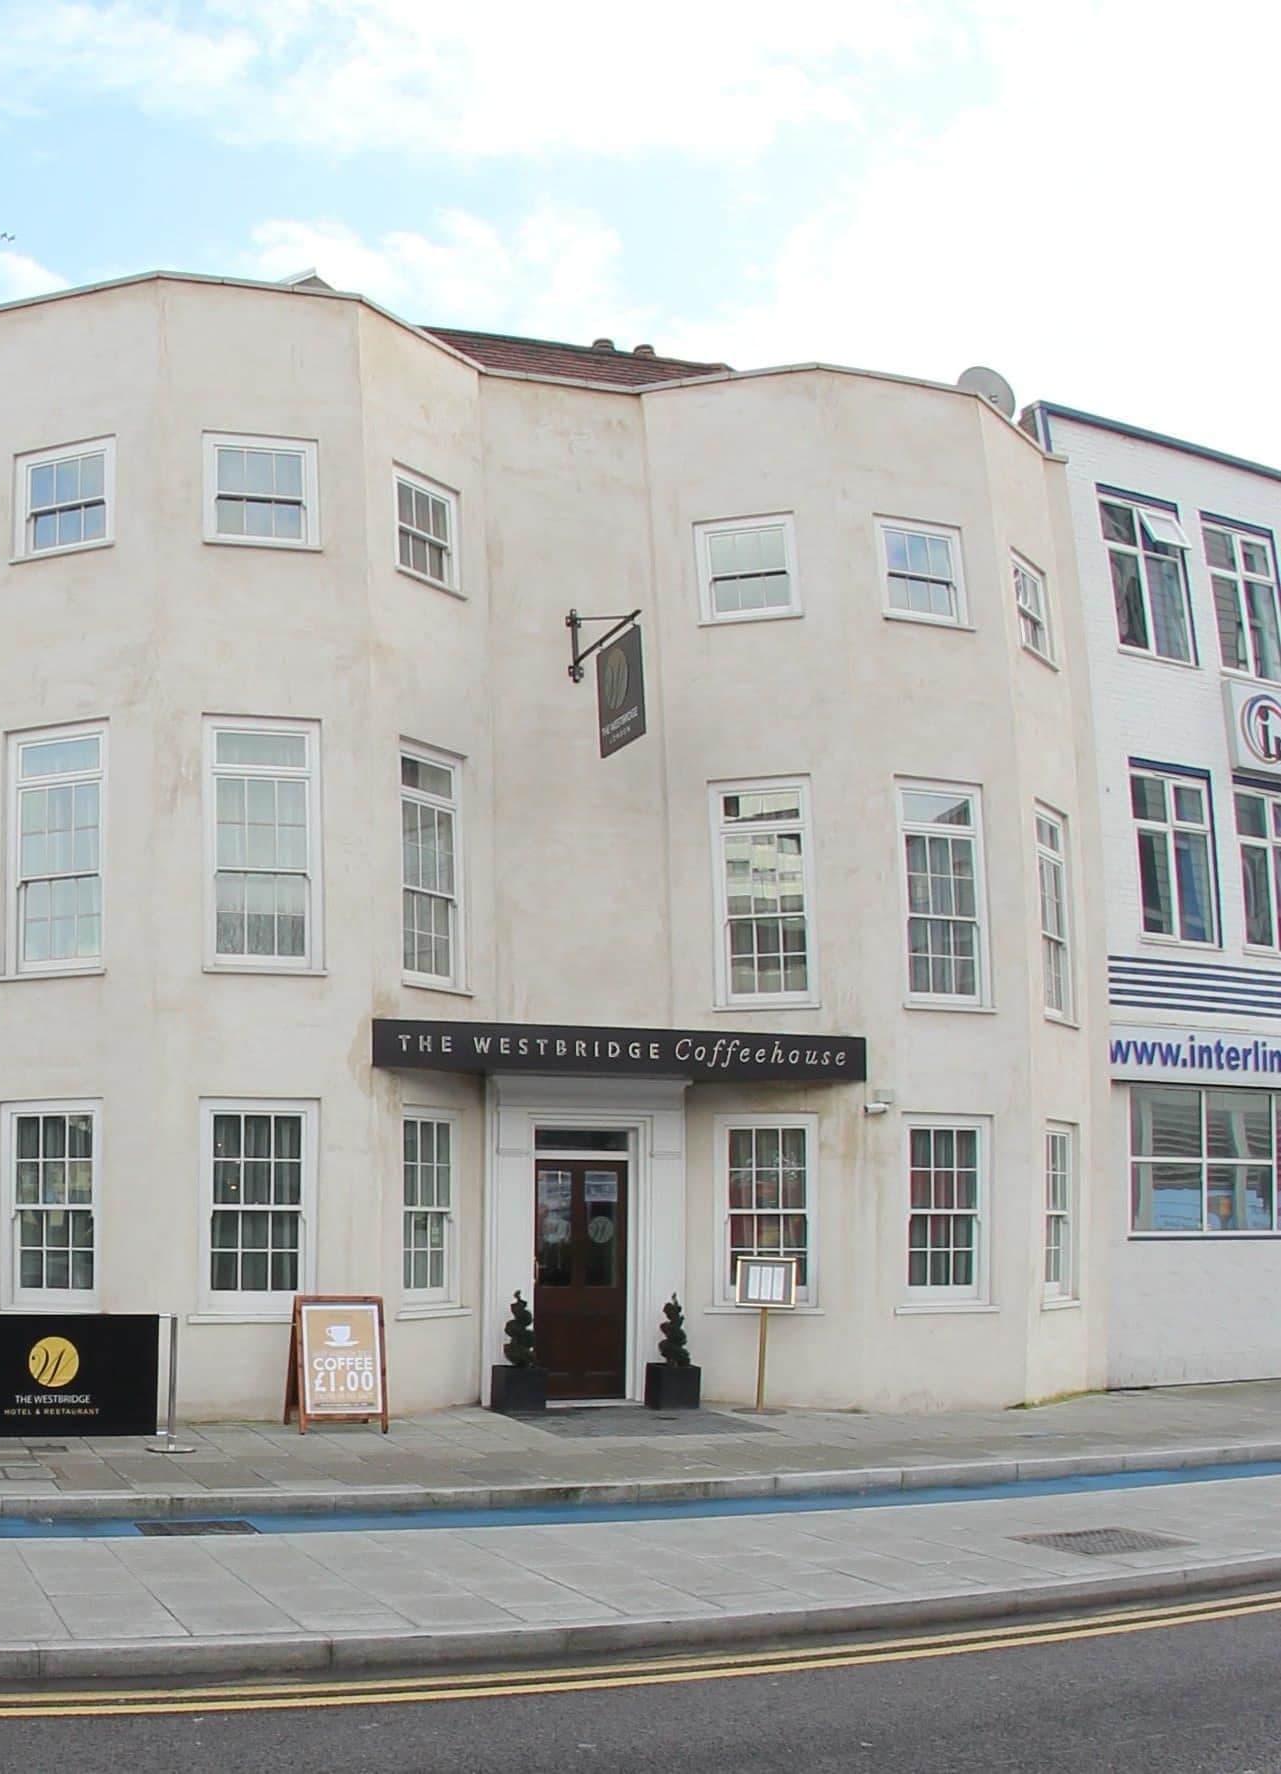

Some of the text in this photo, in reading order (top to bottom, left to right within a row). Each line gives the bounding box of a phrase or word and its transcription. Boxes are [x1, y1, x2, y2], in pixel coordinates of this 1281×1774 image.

[398, 1034, 848, 1068] THE WESTBRIDGE Coffeehouse
[1109, 1034, 1281, 1073] www.interlin
[313, 1358, 374, 1371] COFFEE
[313, 1371, 375, 1393] £1.00
[15, 1394, 91, 1404] THE WESTBRIDGE
